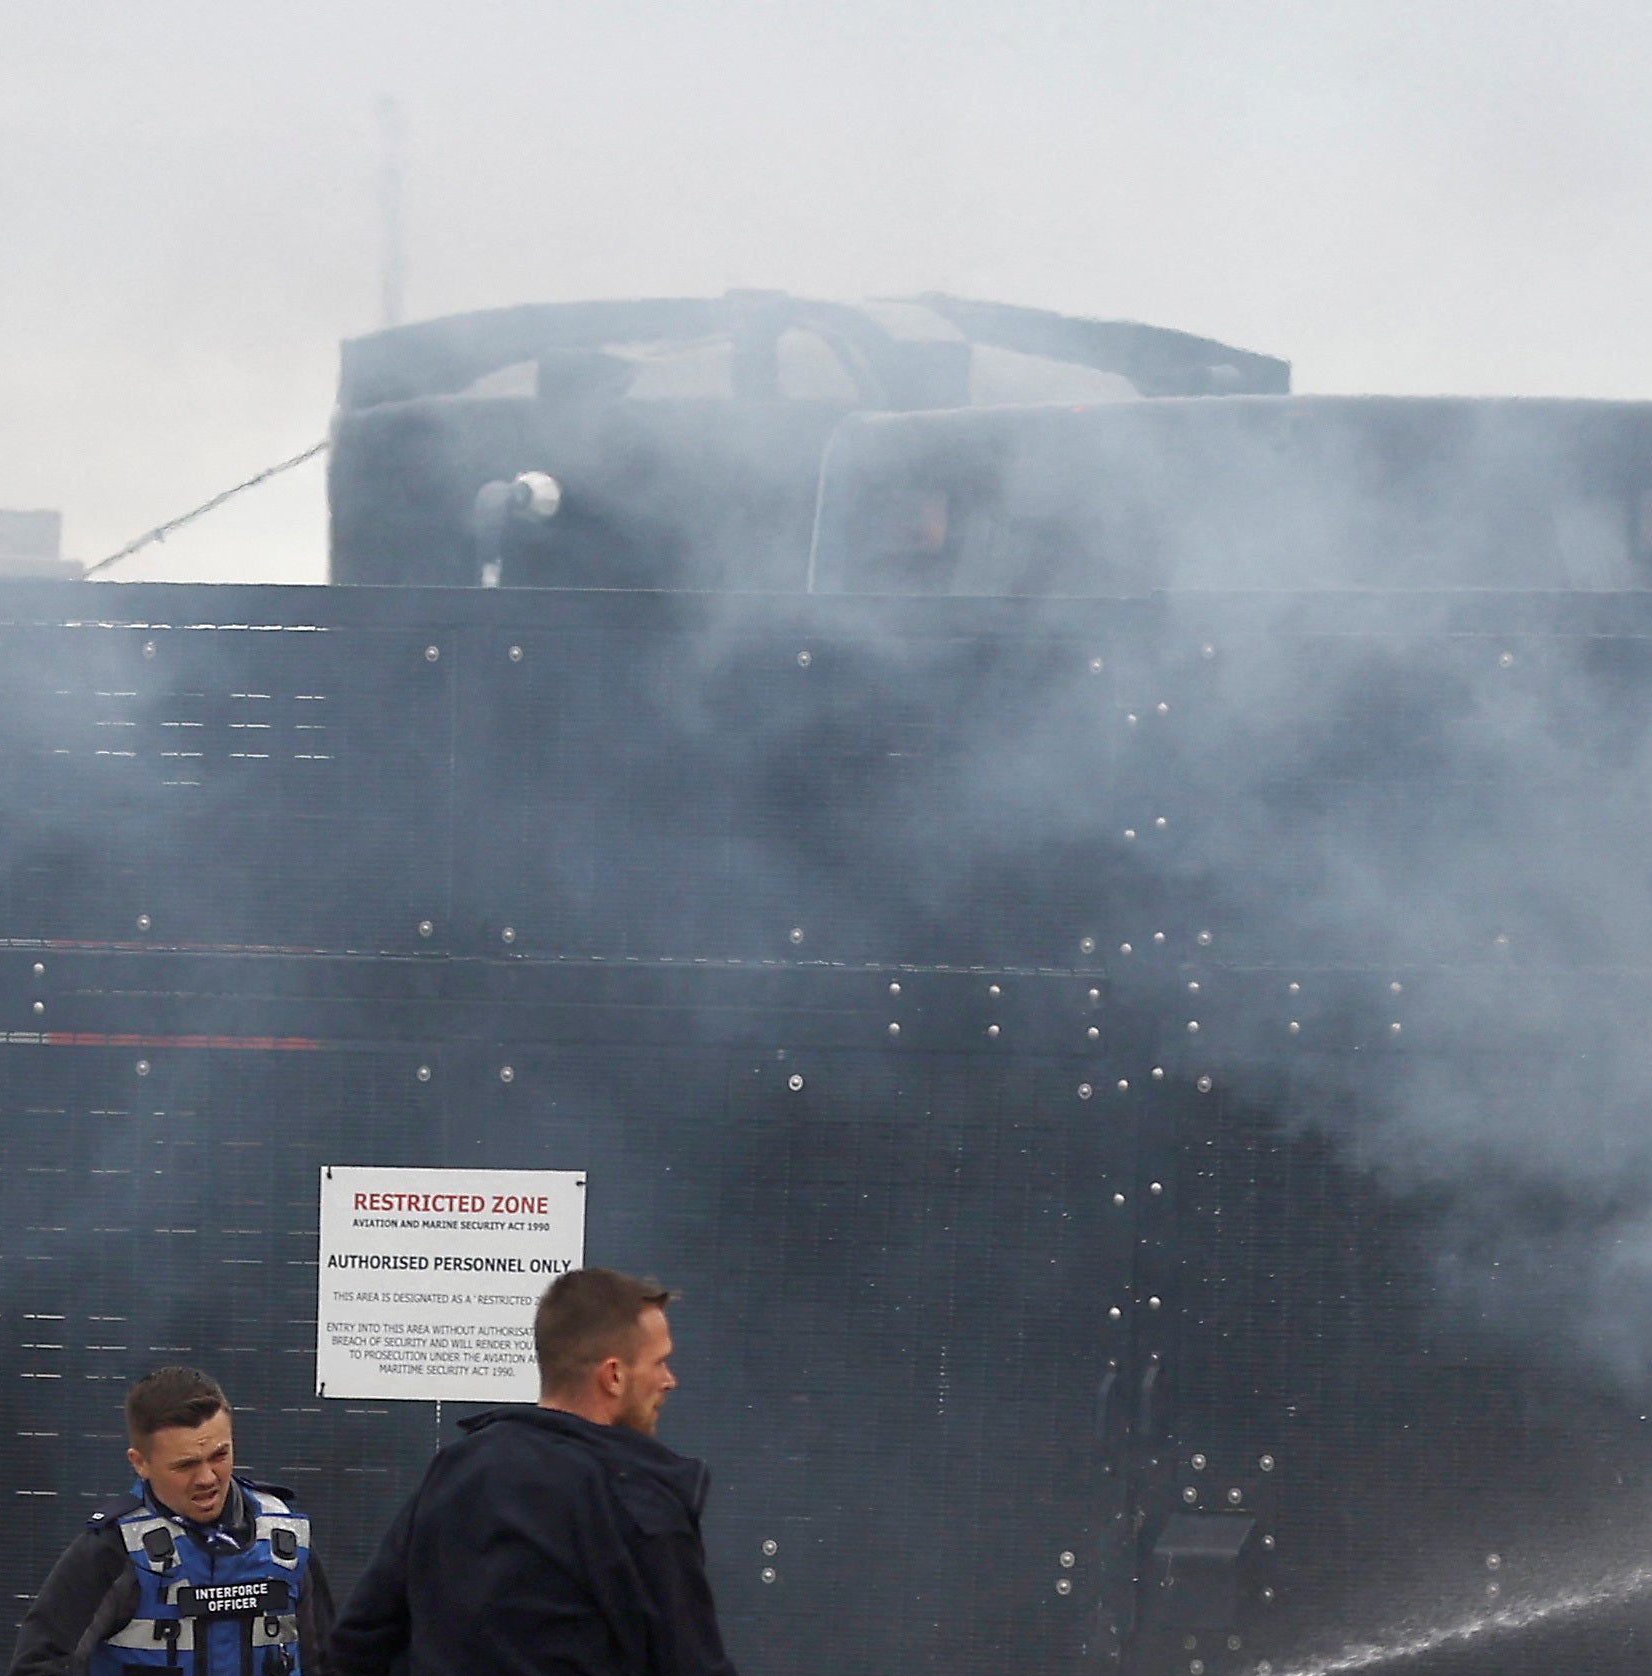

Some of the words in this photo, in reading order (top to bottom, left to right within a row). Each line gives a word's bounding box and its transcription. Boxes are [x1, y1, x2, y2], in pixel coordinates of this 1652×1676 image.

[354, 1192, 485, 1213] RESTRICTED
[492, 1195, 548, 1214] ZONE
[352, 1218, 398, 1229] AVIATION
[400, 1219, 420, 1229] AND
[422, 1220, 458, 1230] MARINE
[460, 1220, 506, 1231] SECURITY
[508, 1222, 525, 1231] ACT
[527, 1222, 550, 1232] 1990
[327, 1254, 429, 1271] AUTHORISED
[434, 1256, 525, 1273] PERSONNEL
[530, 1258, 571, 1274] ONLY
[333, 1291, 354, 1301] THIS
[356, 1292, 380, 1302] AREA
[381, 1292, 391, 1303] IS
[393, 1292, 449, 1304] DESIGNATED
[451, 1294, 463, 1304] AS
[465, 1294, 471, 1304] A
[327, 1321, 355, 1332] ENTRY
[358, 1323, 381, 1333] INTO
[383, 1323, 405, 1334] THIS
[406, 1324, 429, 1334] AREA
[433, 1325, 475, 1336] WITHOUT
[332, 1335, 367, 1346] BREACH
[370, 1336, 381, 1347] OF
[384, 1337, 427, 1348] SECURITY
[429, 1338, 449, 1348] AND
[452, 1339, 474, 1349] WILL
[476, 1339, 511, 1350] RENDER
[513, 1340, 533, 1351] YOU
[349, 1349, 362, 1360] TO
[364, 1350, 427, 1361] PROSECUTION
[429, 1352, 460, 1362] UNDER
[463, 1353, 481, 1363] THE
[483, 1353, 526, 1364] AVIATION
[379, 1363, 423, 1375] MARITIME
[426, 1365, 469, 1376] SECURITY
[471, 1366, 490, 1376] ACT
[195, 1583, 268, 1600] INTERFORCE
[208, 1597, 257, 1612] OFFICER
